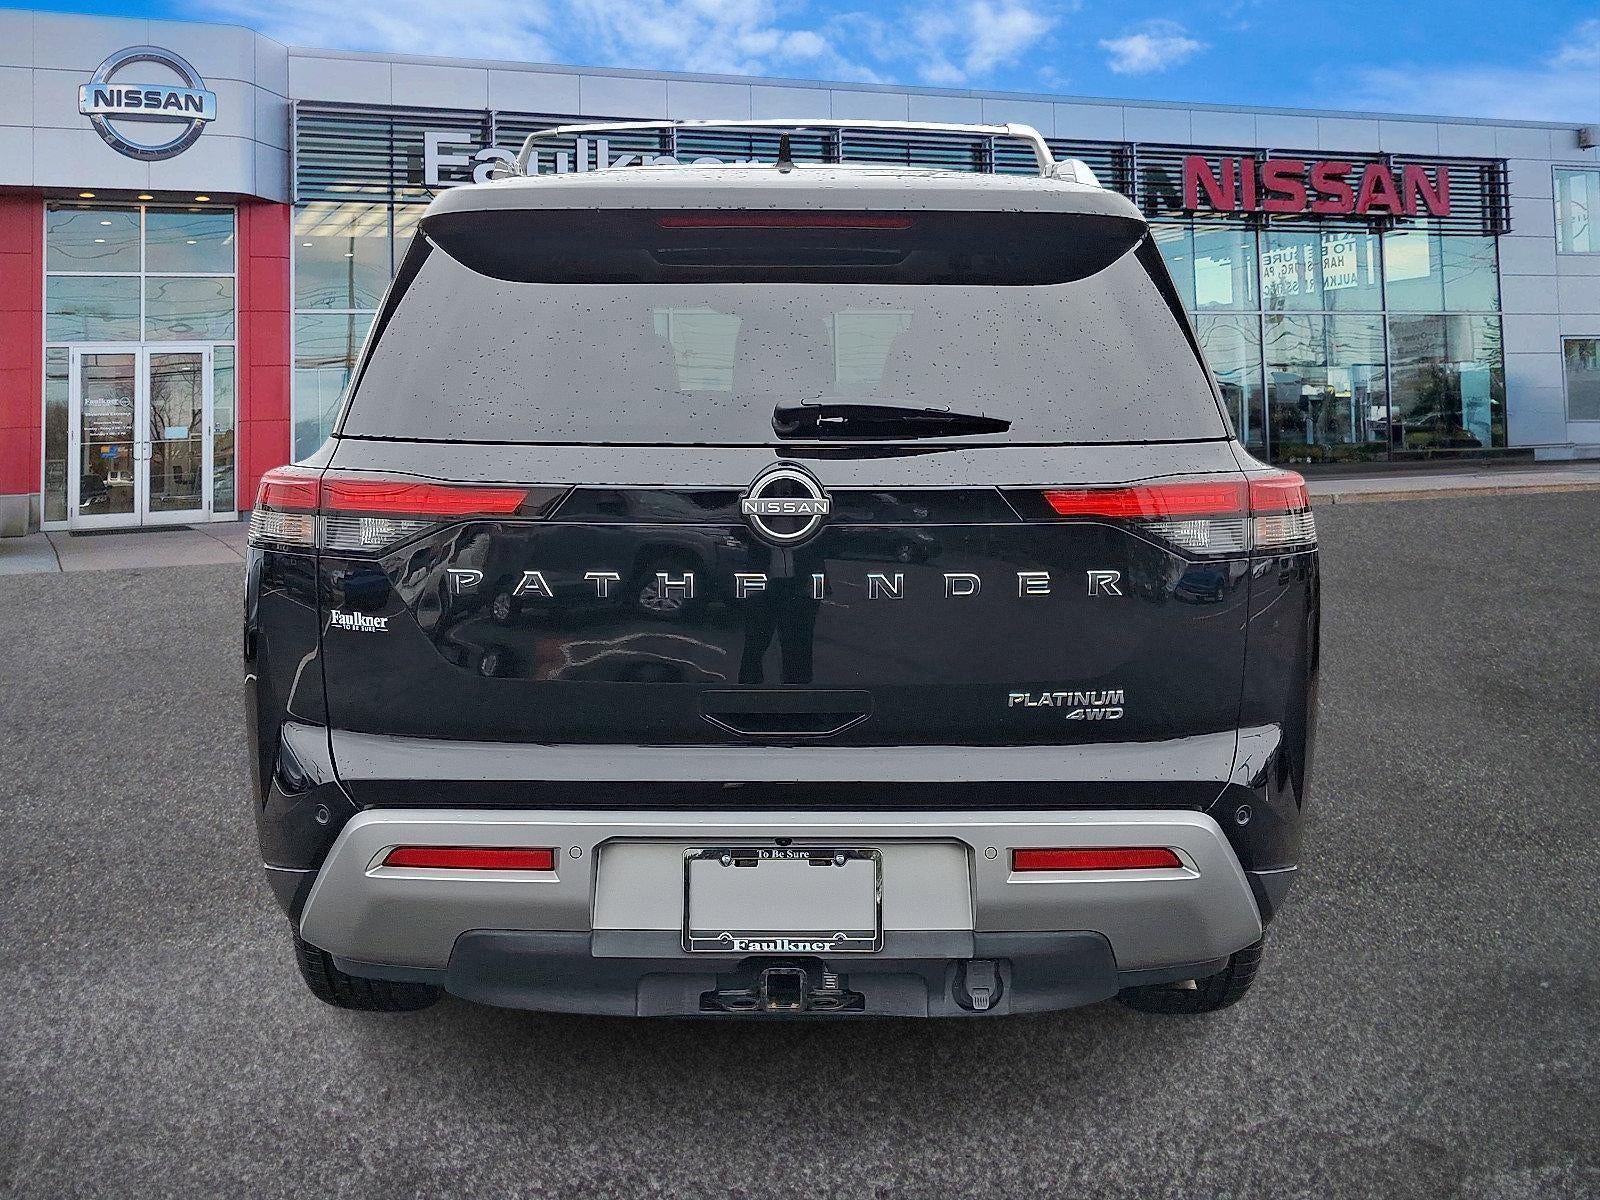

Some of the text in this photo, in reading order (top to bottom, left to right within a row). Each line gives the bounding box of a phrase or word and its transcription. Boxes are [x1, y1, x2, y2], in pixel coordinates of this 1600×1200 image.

[93, 88, 204, 113] NISSAN
[1182, 154, 1451, 217] NISSAN
[744, 501, 827, 513] NISSAN
[446, 568, 1123, 600] PATHFINDER
[330, 609, 388, 628] Faulkner
[1008, 689, 1125, 708] PLATINUM
[1065, 707, 1124, 721] 4WD
[757, 849, 810, 859] To Be Sure
[731, 938, 836, 951] Faulkner
